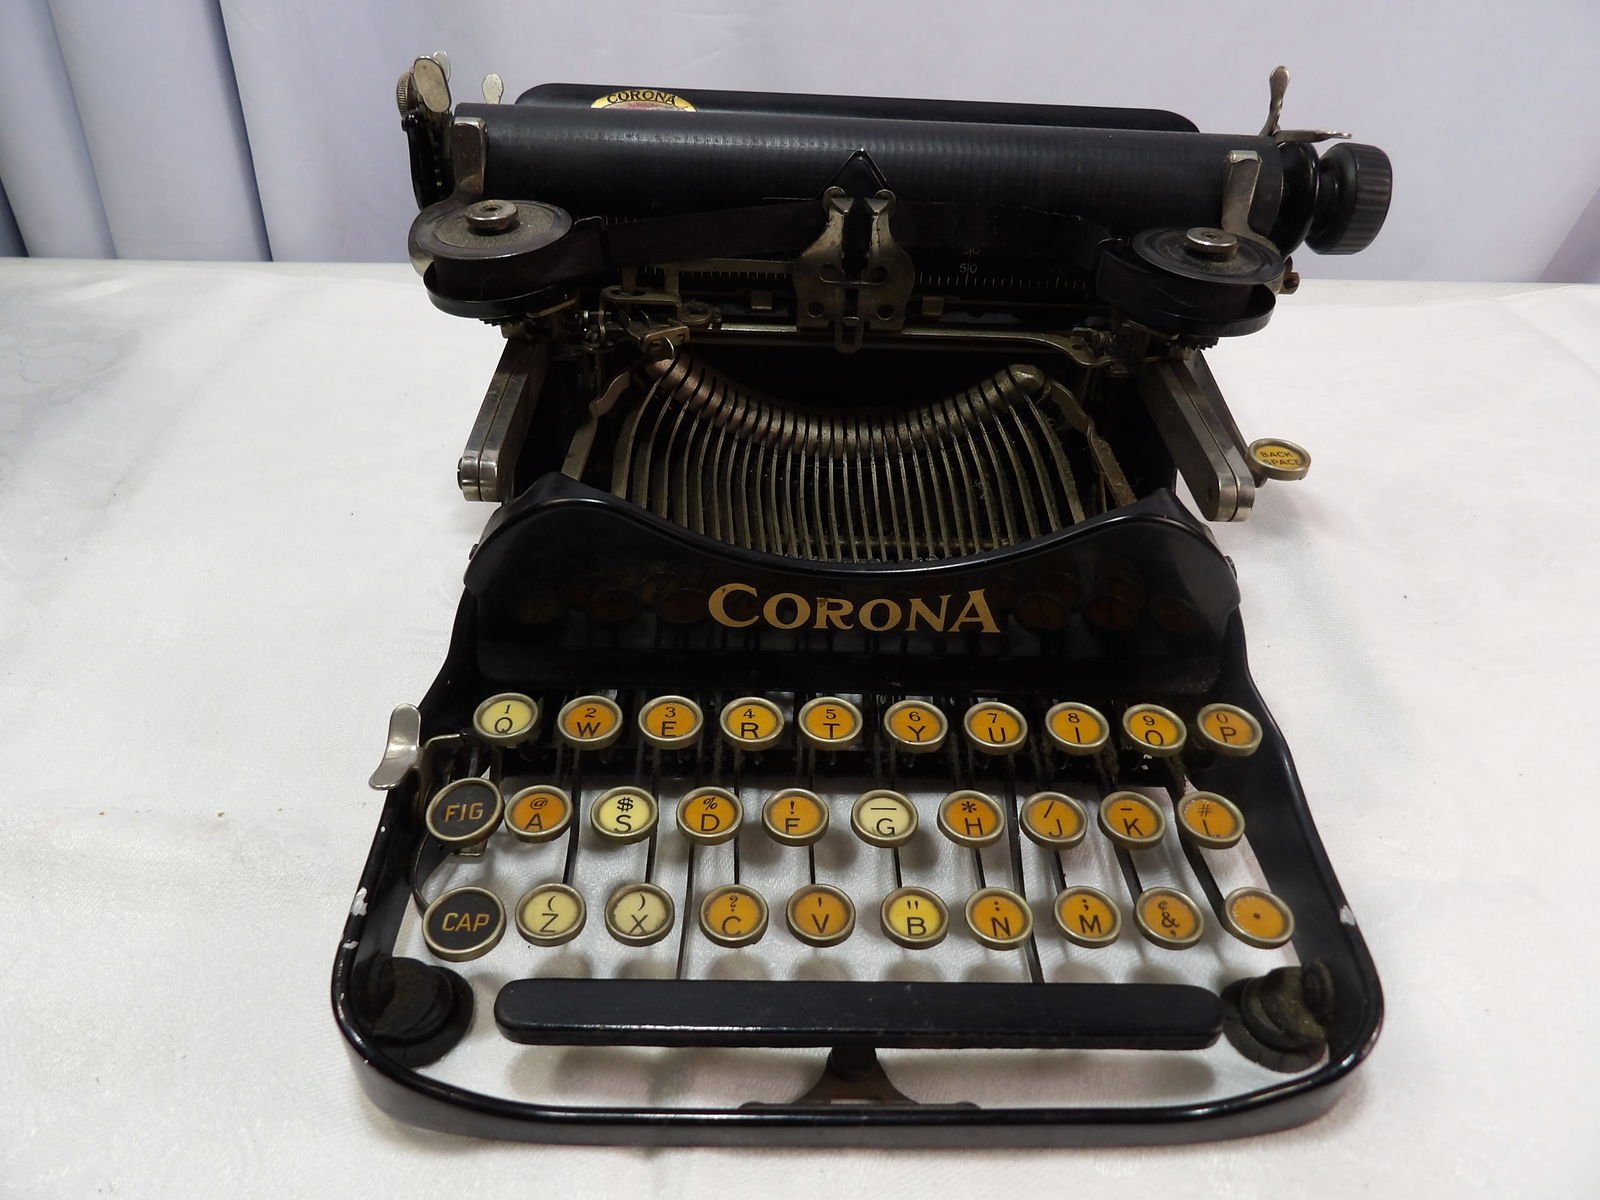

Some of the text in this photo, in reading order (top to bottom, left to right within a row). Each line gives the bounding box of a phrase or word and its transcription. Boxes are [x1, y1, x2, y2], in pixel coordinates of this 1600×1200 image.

[607, 90, 676, 106] CORONA
[960, 263, 977, 273] 50
[708, 583, 1000, 633] CORONA
[504, 704, 511, 714] 1
[584, 708, 597, 718] 2
[664, 706, 676, 718] 3
[743, 709, 755, 719] 4
[825, 709, 837, 720] 5
[909, 712, 921, 722] 6
[1068, 712, 1080, 723] 8
[494, 717, 513, 734] Q
[987, 713, 998, 724] 7
[1143, 715, 1155, 726] 9
[576, 721, 602, 738] W
[660, 721, 677, 737] E
[740, 722, 760, 739] R
[823, 723, 841, 740] T
[906, 725, 926, 742] Y
[988, 727, 1007, 743] U
[1144, 729, 1164, 746] O
[1219, 726, 1237, 743] P
[530, 798, 548, 810] @
[616, 797, 634, 813] $
[703, 797, 718, 810] %
[789, 800, 795, 815] !
[1198, 804, 1213, 816] #
[444, 802, 484, 823] FIG
[525, 813, 544, 830] A
[614, 814, 632, 833] S
[700, 813, 720, 832] D
[785, 817, 801, 835] F
[875, 818, 896, 836] G
[964, 817, 984, 836] H
[1048, 818, 1064, 837] J
[1122, 817, 1144, 836] K
[729, 895, 738, 912] ?
[441, 912, 490, 932] CAP
[539, 913, 559, 933] Z
[630, 914, 648, 934] X
[721, 916, 741, 936] C
[811, 914, 830, 934] V
[906, 917, 927, 936] B
[991, 917, 1011, 937] N
[1078, 915, 1102, 935] M
[1161, 911, 1180, 929] &
